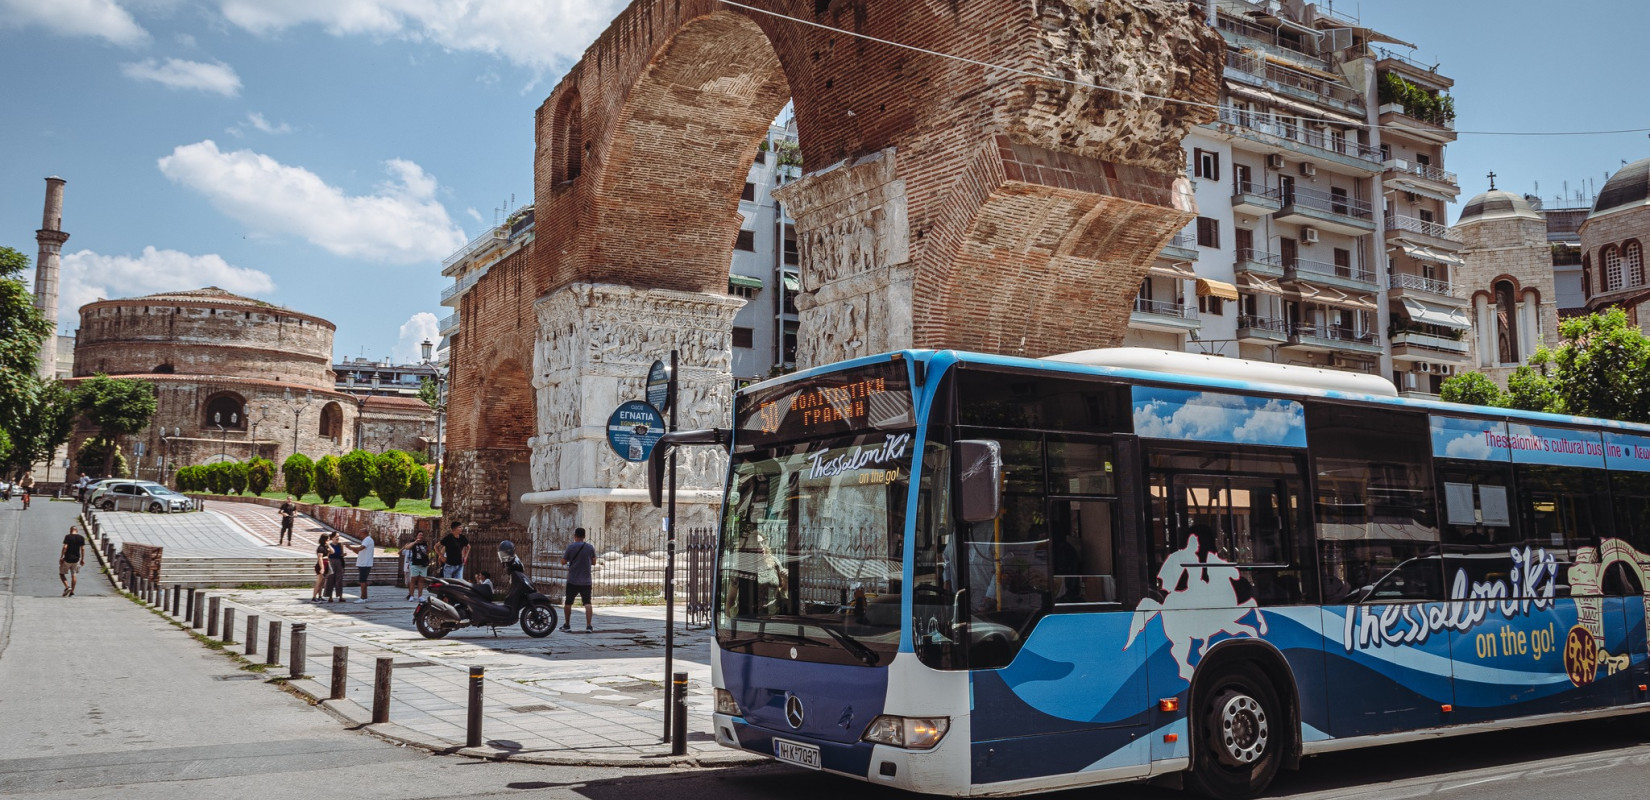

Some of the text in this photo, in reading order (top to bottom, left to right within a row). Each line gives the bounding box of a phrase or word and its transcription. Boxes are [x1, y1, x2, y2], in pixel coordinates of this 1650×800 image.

[620, 410, 654, 421] ΕΓΝΑΤΙΑ
[760, 400, 779, 434] 50
[1551, 437, 1585, 455] cultural
[1586, 439, 1603, 456] bus
[1605, 441, 1622, 458] line
[859, 466, 900, 485] on the go!
[1475, 622, 1556, 661] on the go!
